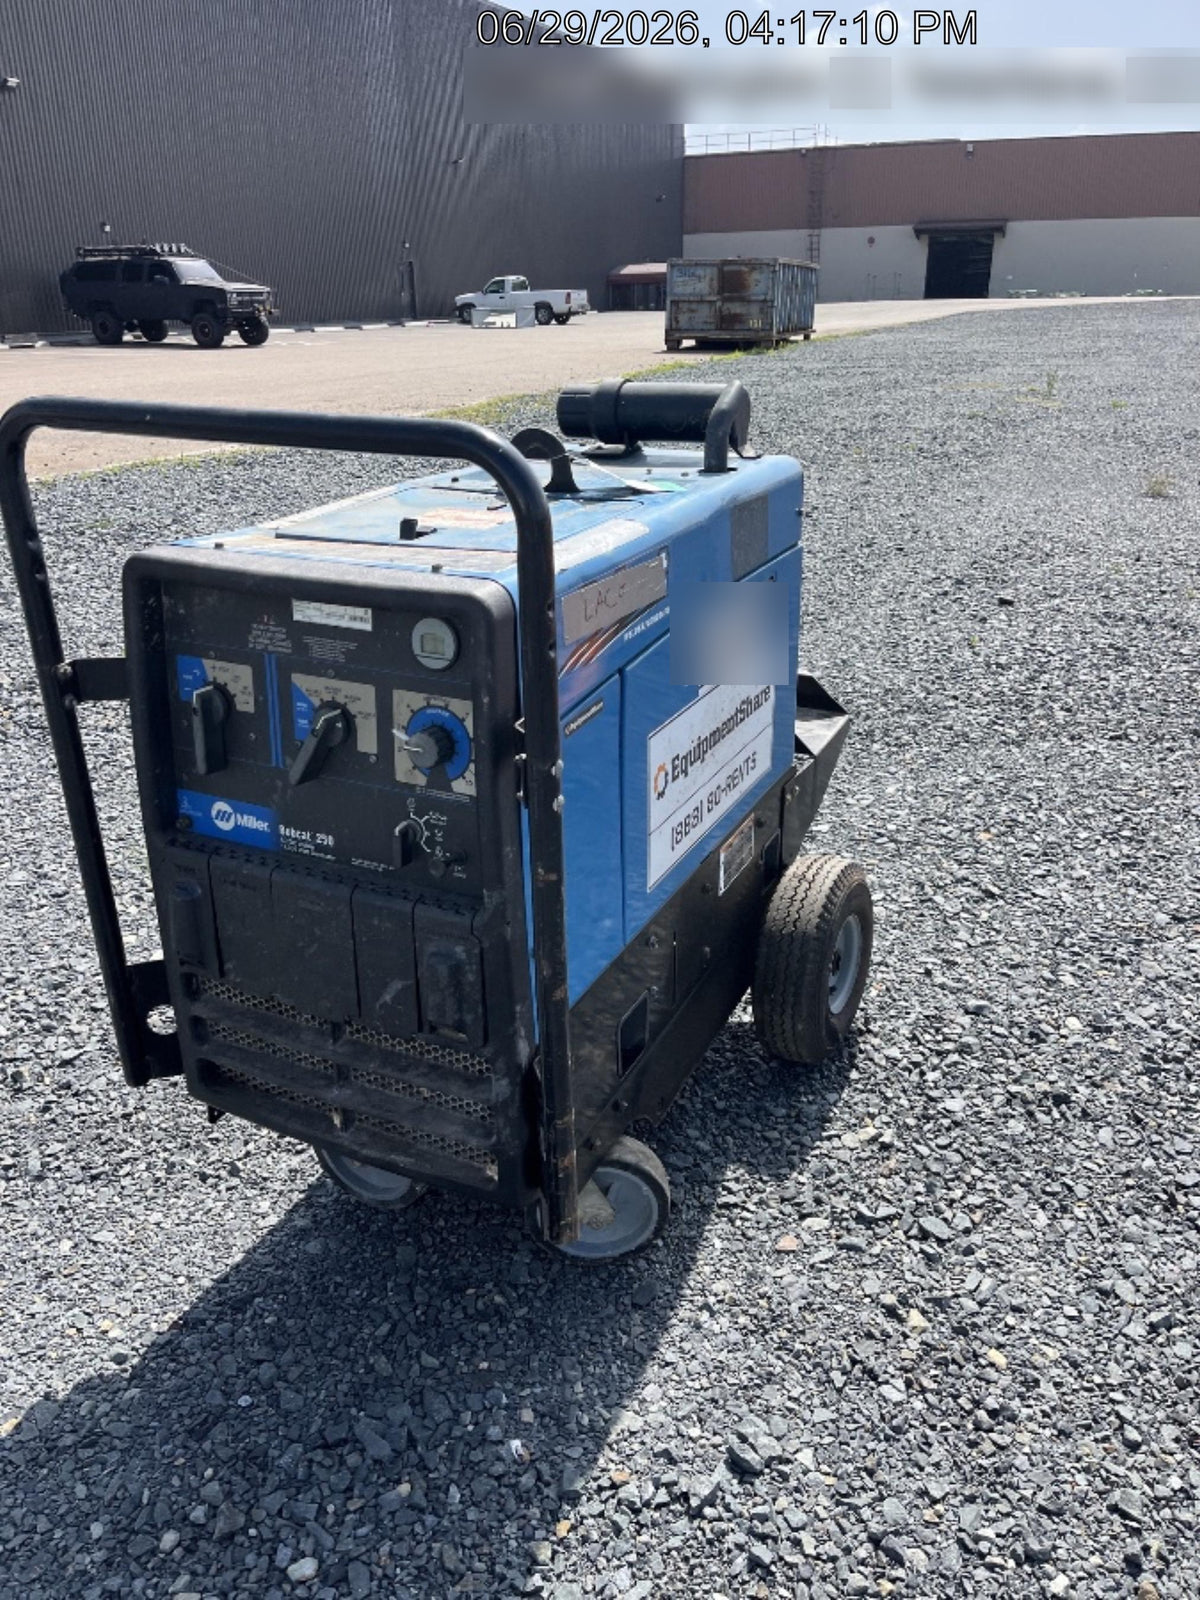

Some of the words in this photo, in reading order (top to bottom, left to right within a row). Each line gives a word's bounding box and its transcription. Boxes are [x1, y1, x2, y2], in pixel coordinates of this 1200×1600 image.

[671, 685, 771, 783] EquipmentShare
[235, 813, 268, 832] Miller
[278, 824, 311, 841] Bobcat
